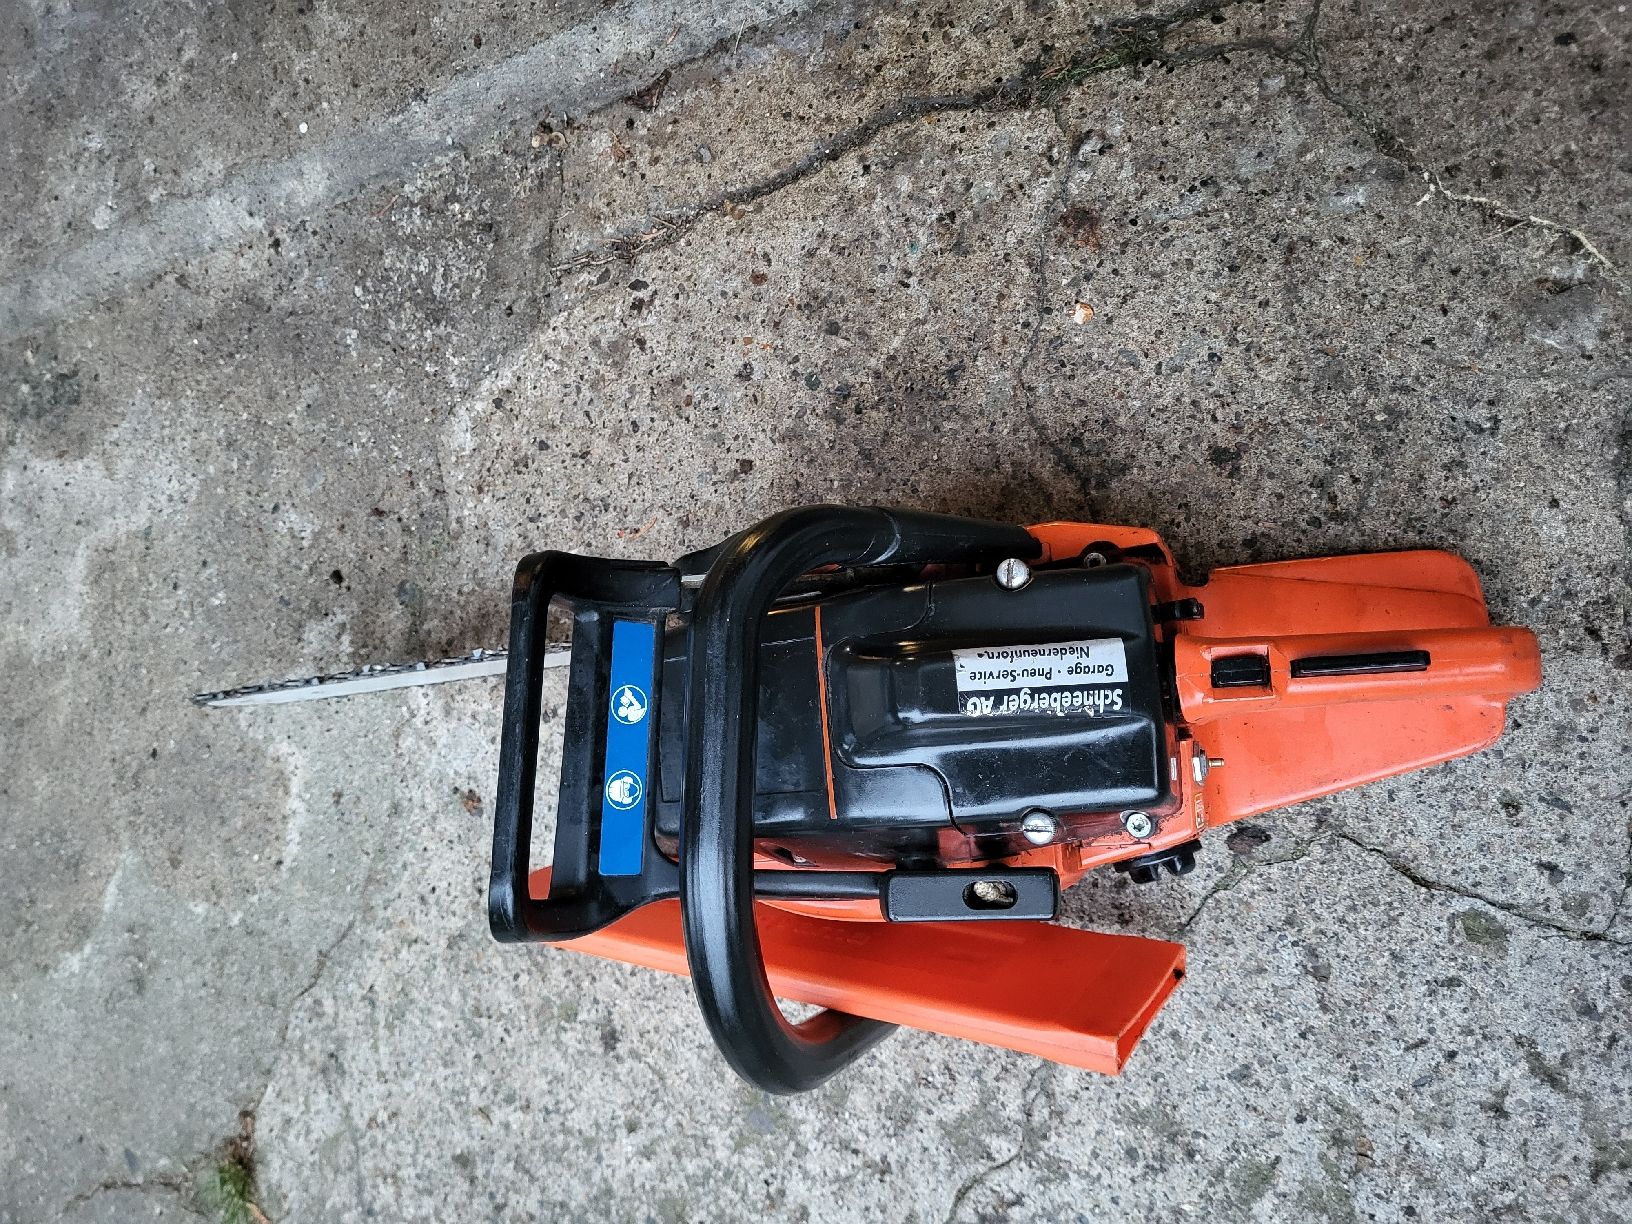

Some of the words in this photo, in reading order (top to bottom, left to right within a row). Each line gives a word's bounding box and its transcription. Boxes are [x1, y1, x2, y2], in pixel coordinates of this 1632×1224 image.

[969, 667, 1052, 684] Pneu-Service
[1067, 662, 1115, 676] Garage
[966, 696, 995, 715] AG
[1000, 687, 1123, 714] Schneeberger
